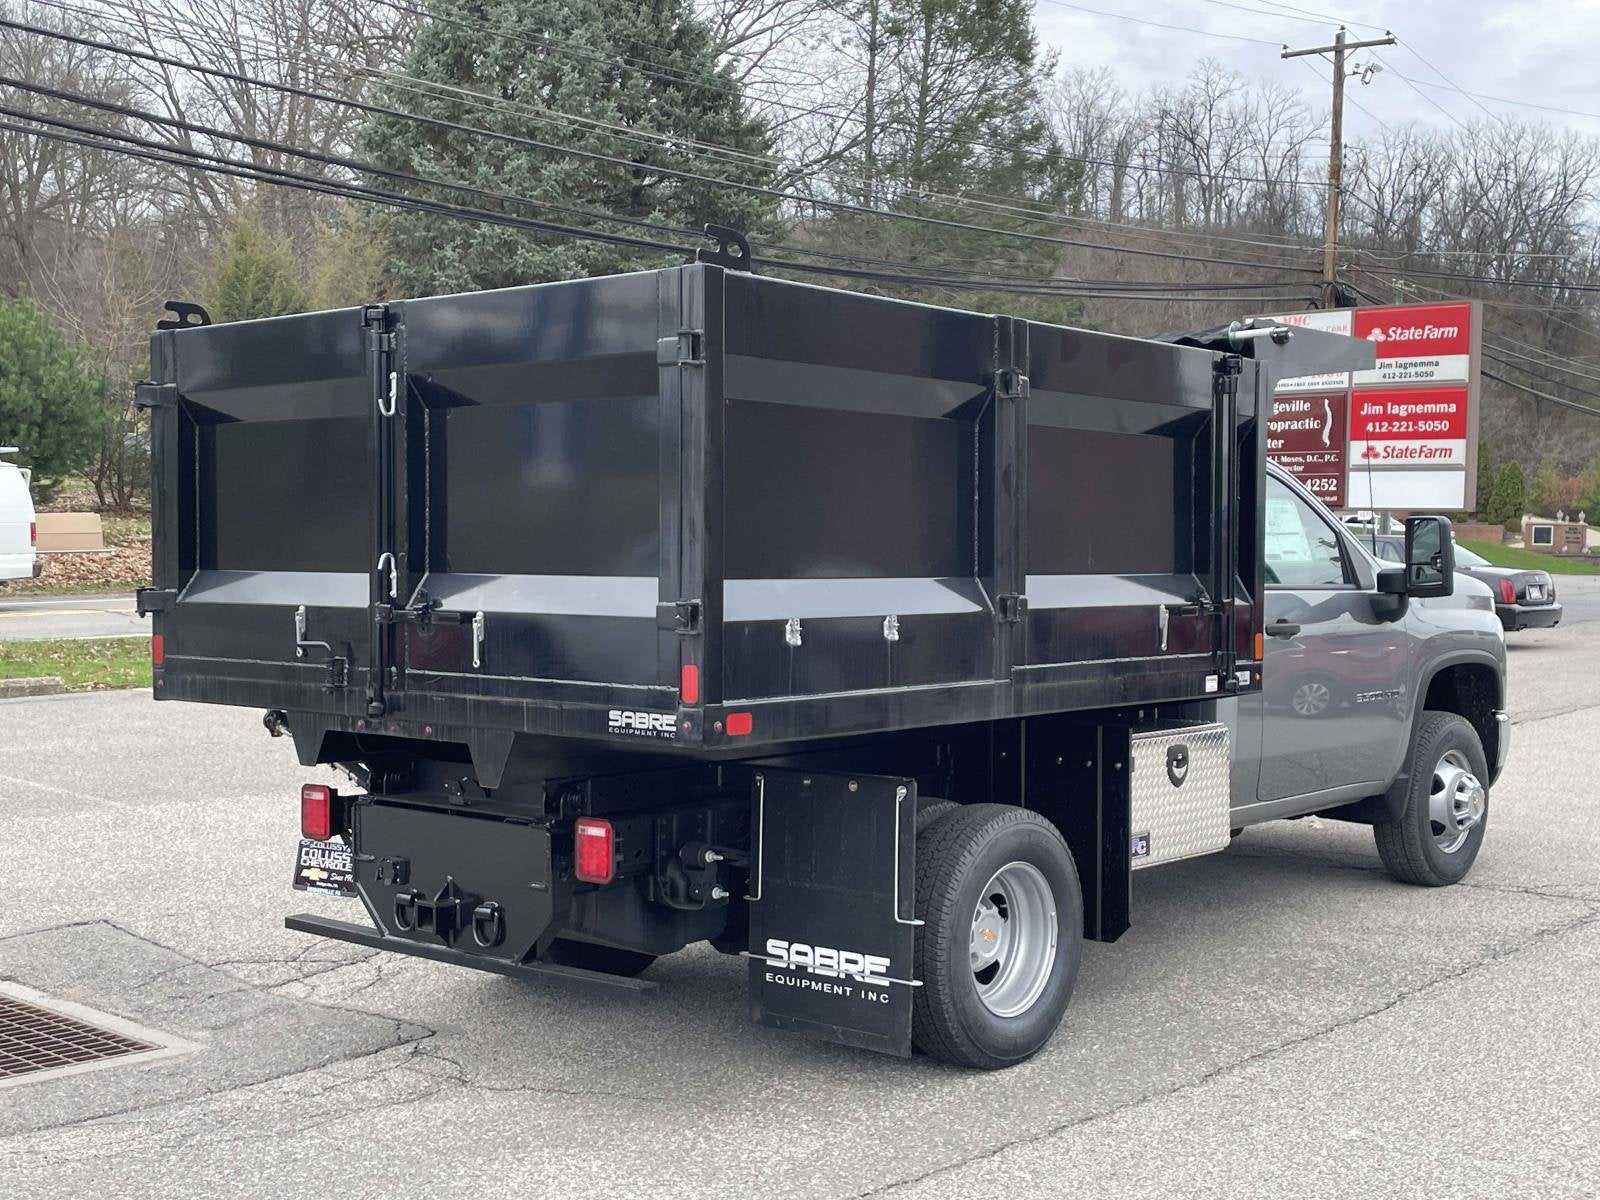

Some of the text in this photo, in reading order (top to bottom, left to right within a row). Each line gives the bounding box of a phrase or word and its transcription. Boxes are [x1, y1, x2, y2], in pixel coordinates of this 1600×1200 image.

[1378, 360, 1439, 370] Jim Iagnemma
[1382, 370, 1434, 379] 412-221-5050
[1360, 402, 1457, 416] Jim Iagnemma
[1366, 420, 1450, 432] 412-221-5050
[608, 710, 677, 732] SABRE
[608, 726, 657, 737] EQUIPMENT
[312, 841, 348, 851] COLUSSY
[301, 847, 353, 864] COLUSS
[766, 938, 890, 987] SABRE
[765, 972, 890, 1004] EQUIPMENT INC
